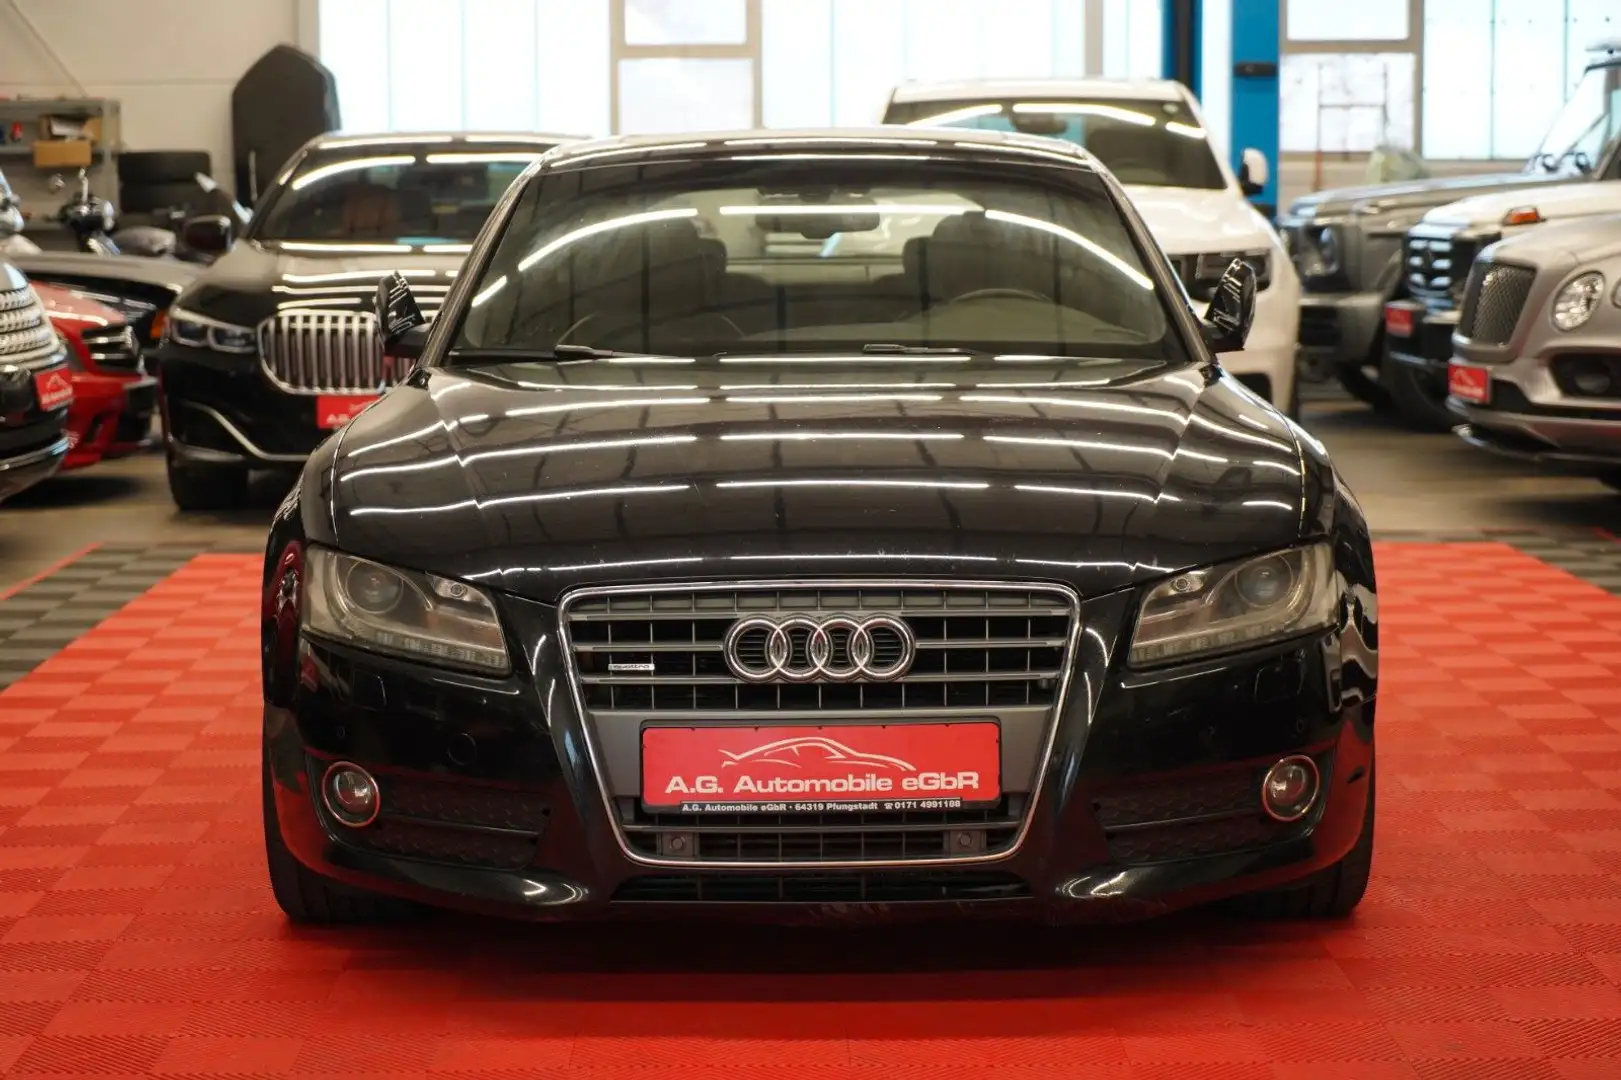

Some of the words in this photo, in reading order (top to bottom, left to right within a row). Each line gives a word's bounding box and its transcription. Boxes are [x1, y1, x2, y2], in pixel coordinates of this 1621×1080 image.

[665, 775, 724, 794] A.G.
[733, 773, 893, 793] Automobile
[901, 771, 979, 790] eGbR
[682, 803, 702, 812] A.G.
[705, 803, 758, 812] Automobile
[761, 803, 787, 812] eGbR
[795, 802, 824, 811] 64319
[826, 802, 878, 812] Pfungstadt
[895, 801, 917, 809] 0171
